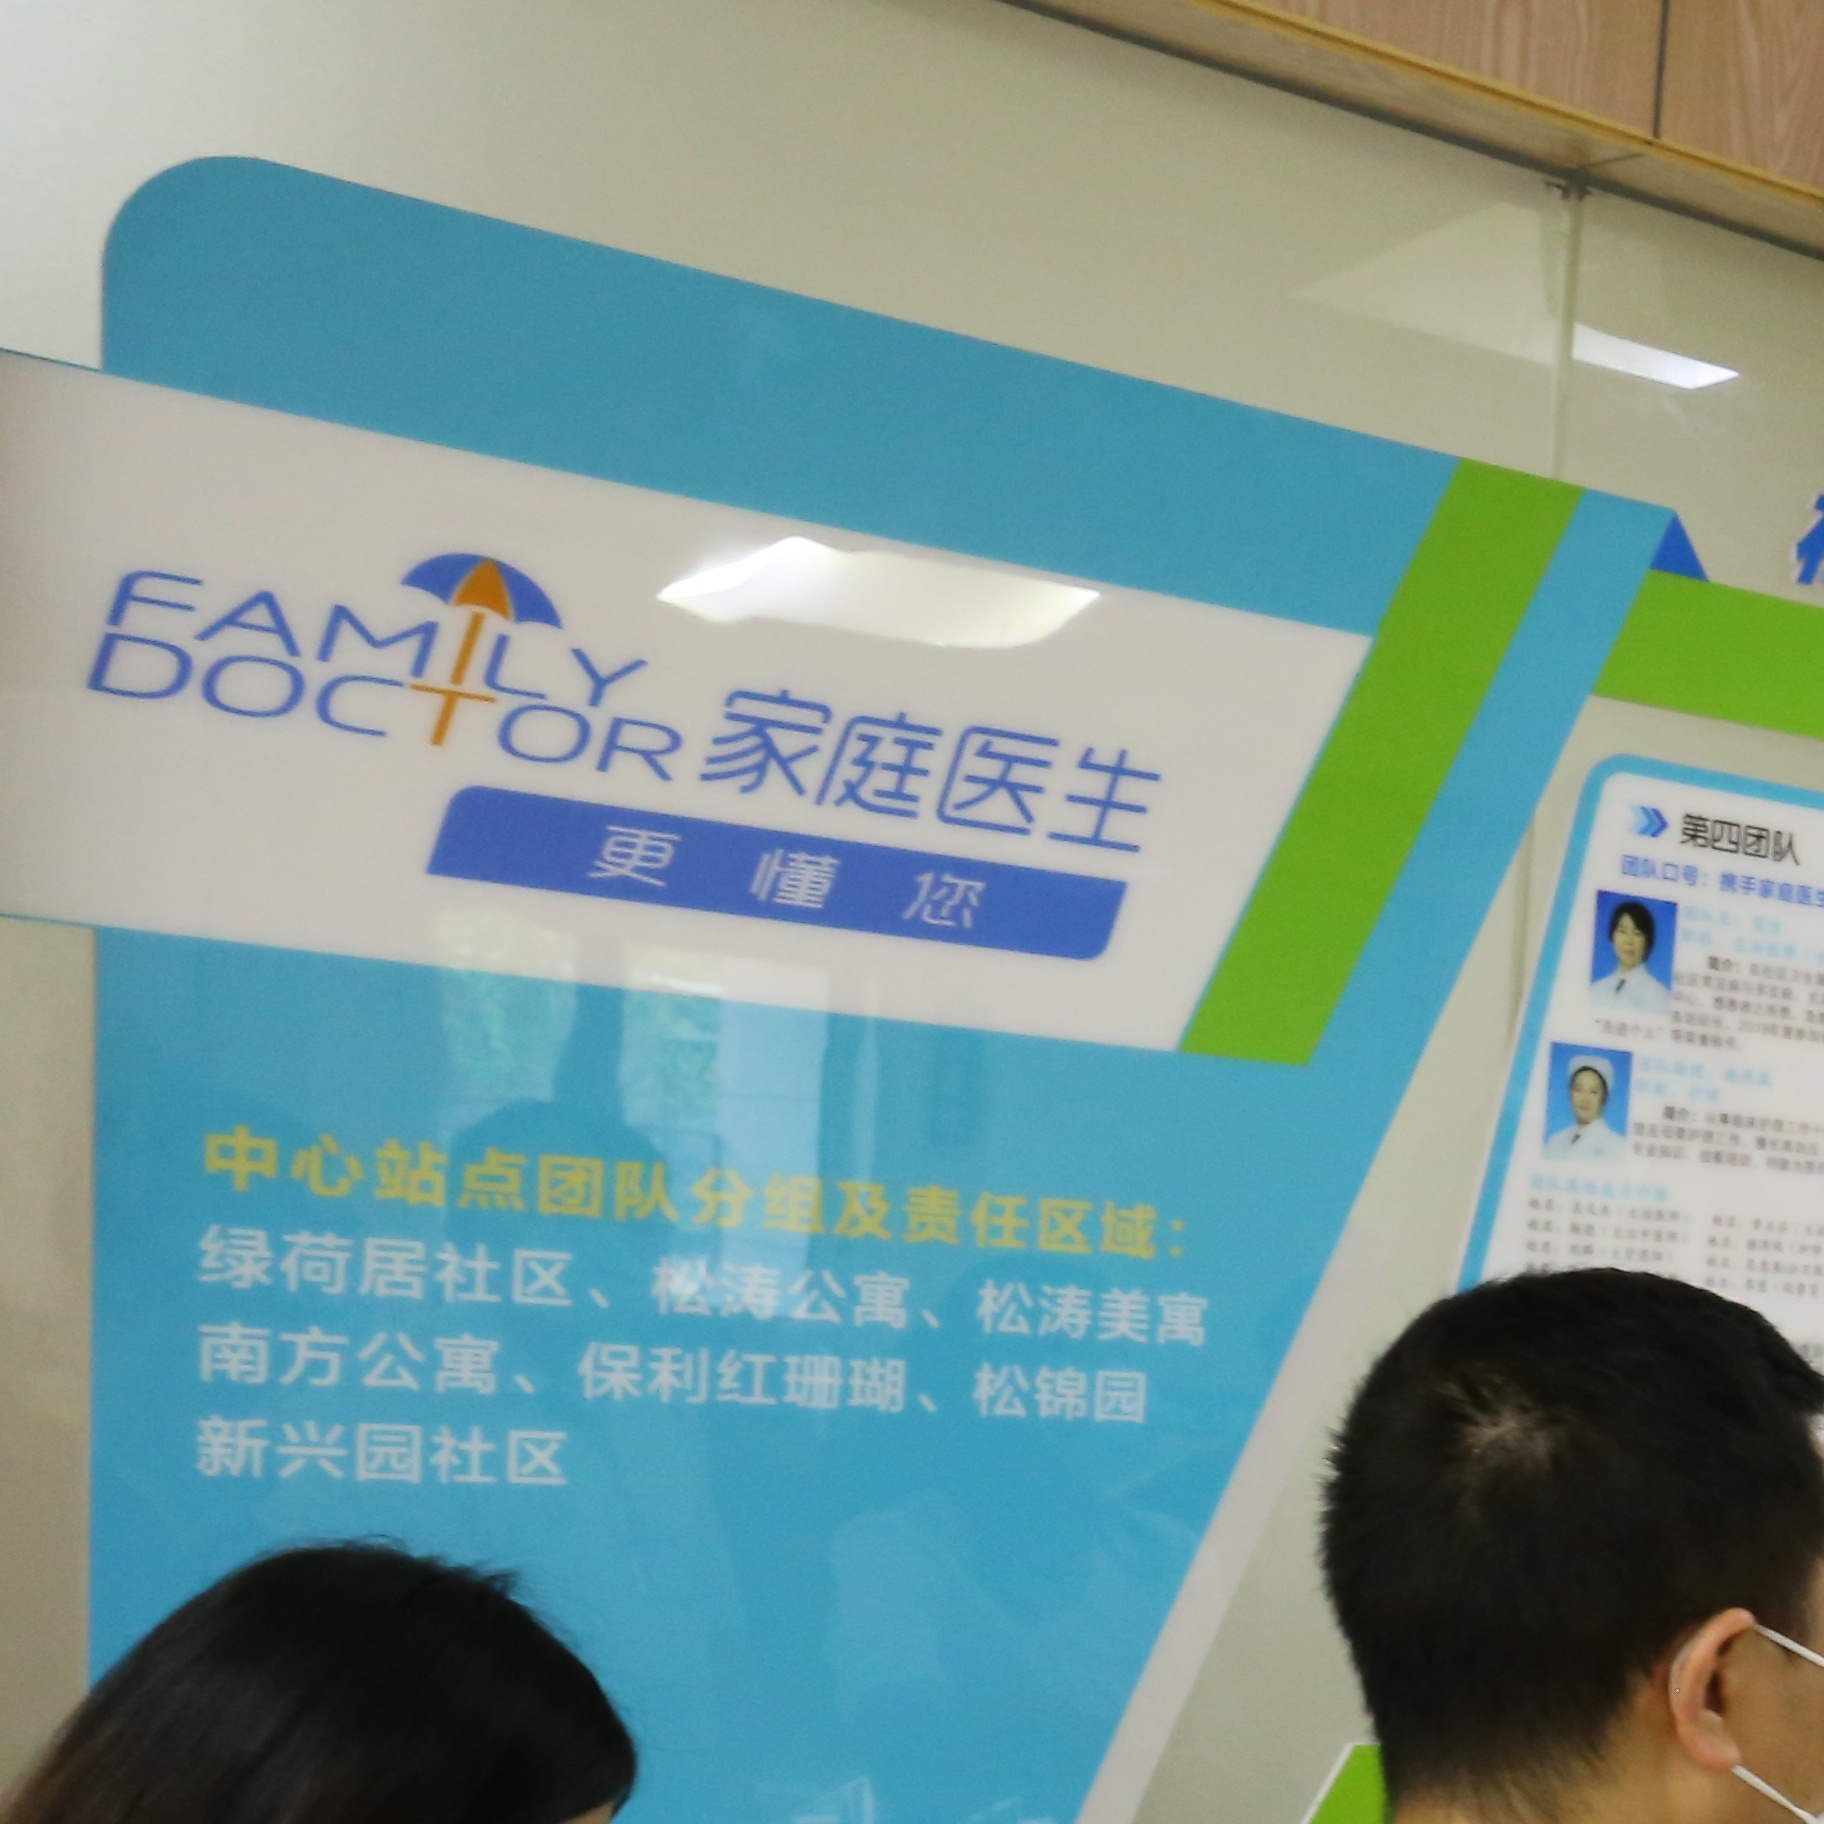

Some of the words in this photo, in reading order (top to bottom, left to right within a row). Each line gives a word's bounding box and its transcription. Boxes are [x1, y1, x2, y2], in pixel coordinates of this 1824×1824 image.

[106, 568, 648, 708] FAMILY
[85, 632, 686, 785] DOCTOR
[700, 688, 1162, 855] 家庭医生
[1680, 814, 1801, 867] 第四团队
[198, 1223, 1210, 1346] 绿荷居社区、松涛公寓、松涛美寓
[197, 1321, 1149, 1424] 南方公寓、保利红珊瑚、松锦园
[195, 1416, 568, 1487] 新兴园社区
